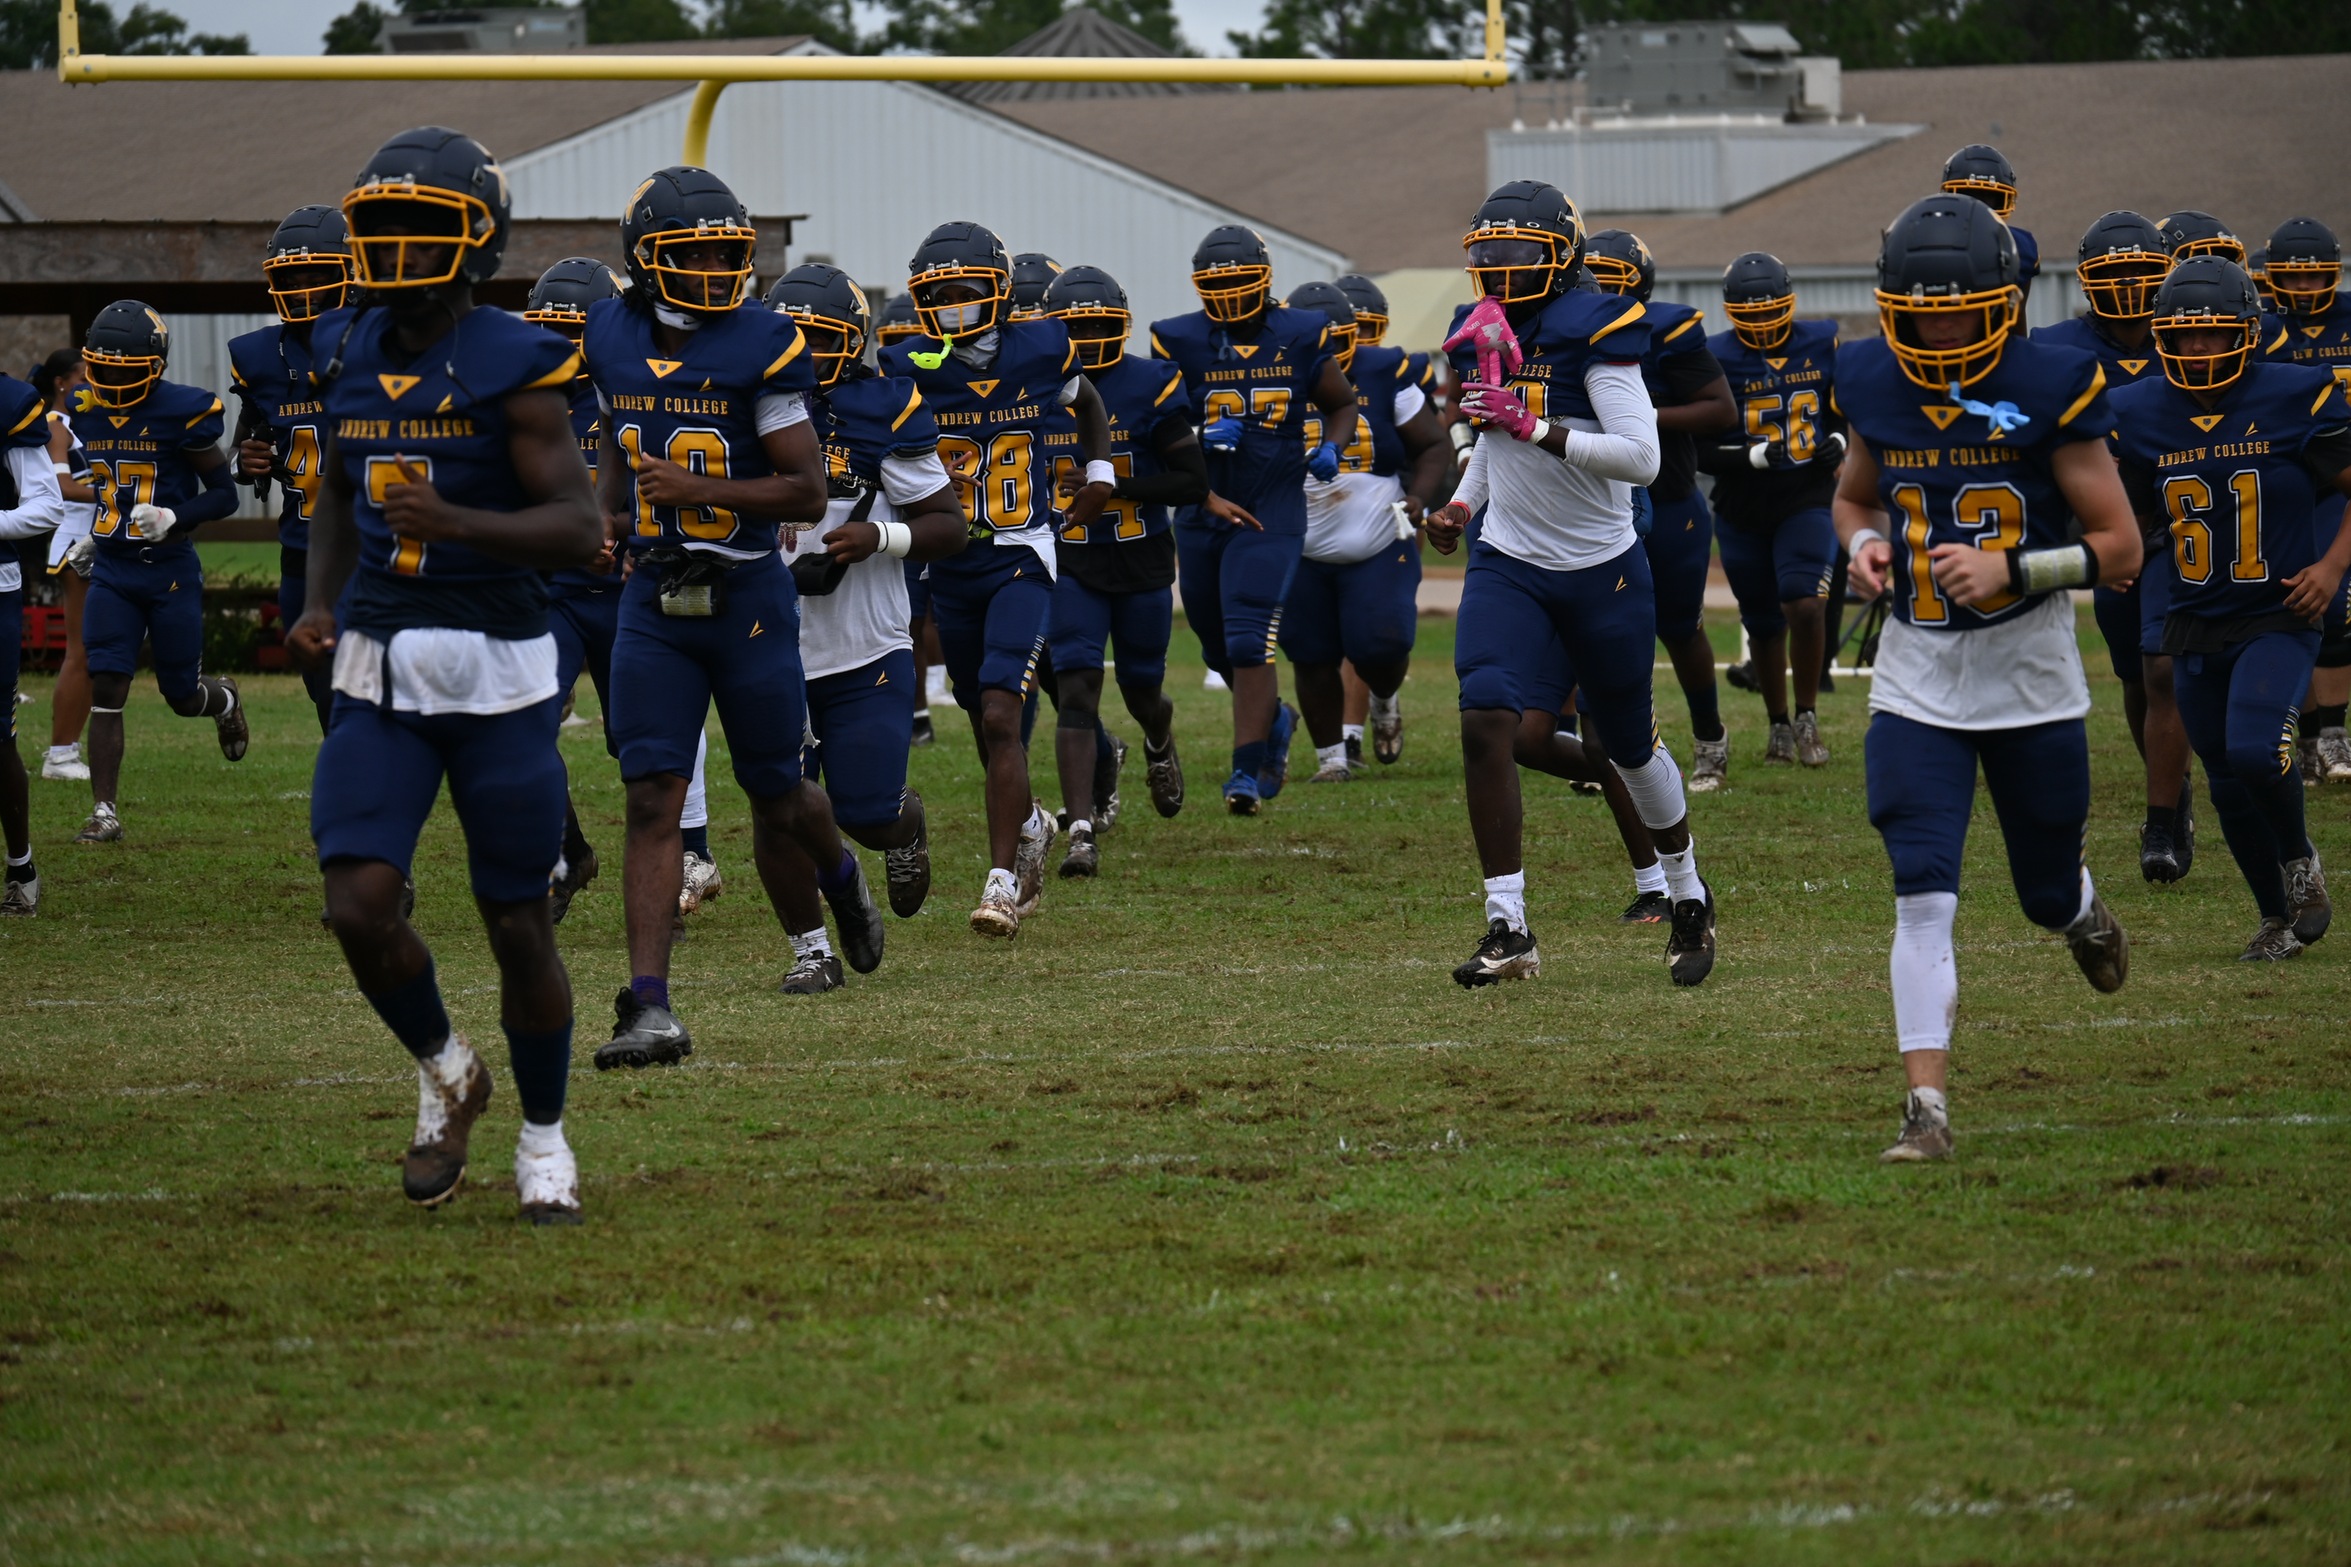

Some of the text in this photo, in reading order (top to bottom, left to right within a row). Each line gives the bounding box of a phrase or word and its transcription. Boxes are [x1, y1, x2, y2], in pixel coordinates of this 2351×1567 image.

[1204, 365, 1293, 382] ANDREW COLLEGE
[1784, 370, 1822, 384] COLLEGE
[278, 400, 323, 417] ANDREW
[612, 394, 728, 415] ANDREW COLLEGE
[933, 404, 1040, 426] ANDREW COLLEGE
[337, 419, 475, 439] ANDREW COLLEGE
[1744, 389, 1820, 465] 56
[118, 440, 158, 451] COLLEGE
[1044, 432, 1079, 446] ANDREW
[1884, 446, 2021, 468] ANDREW COLLEGE
[2158, 441, 2271, 468] ANDREW COLLEGE
[88, 458, 158, 540] 37
[2162, 468, 2269, 586] 61
[1891, 481, 2027, 627] 13
